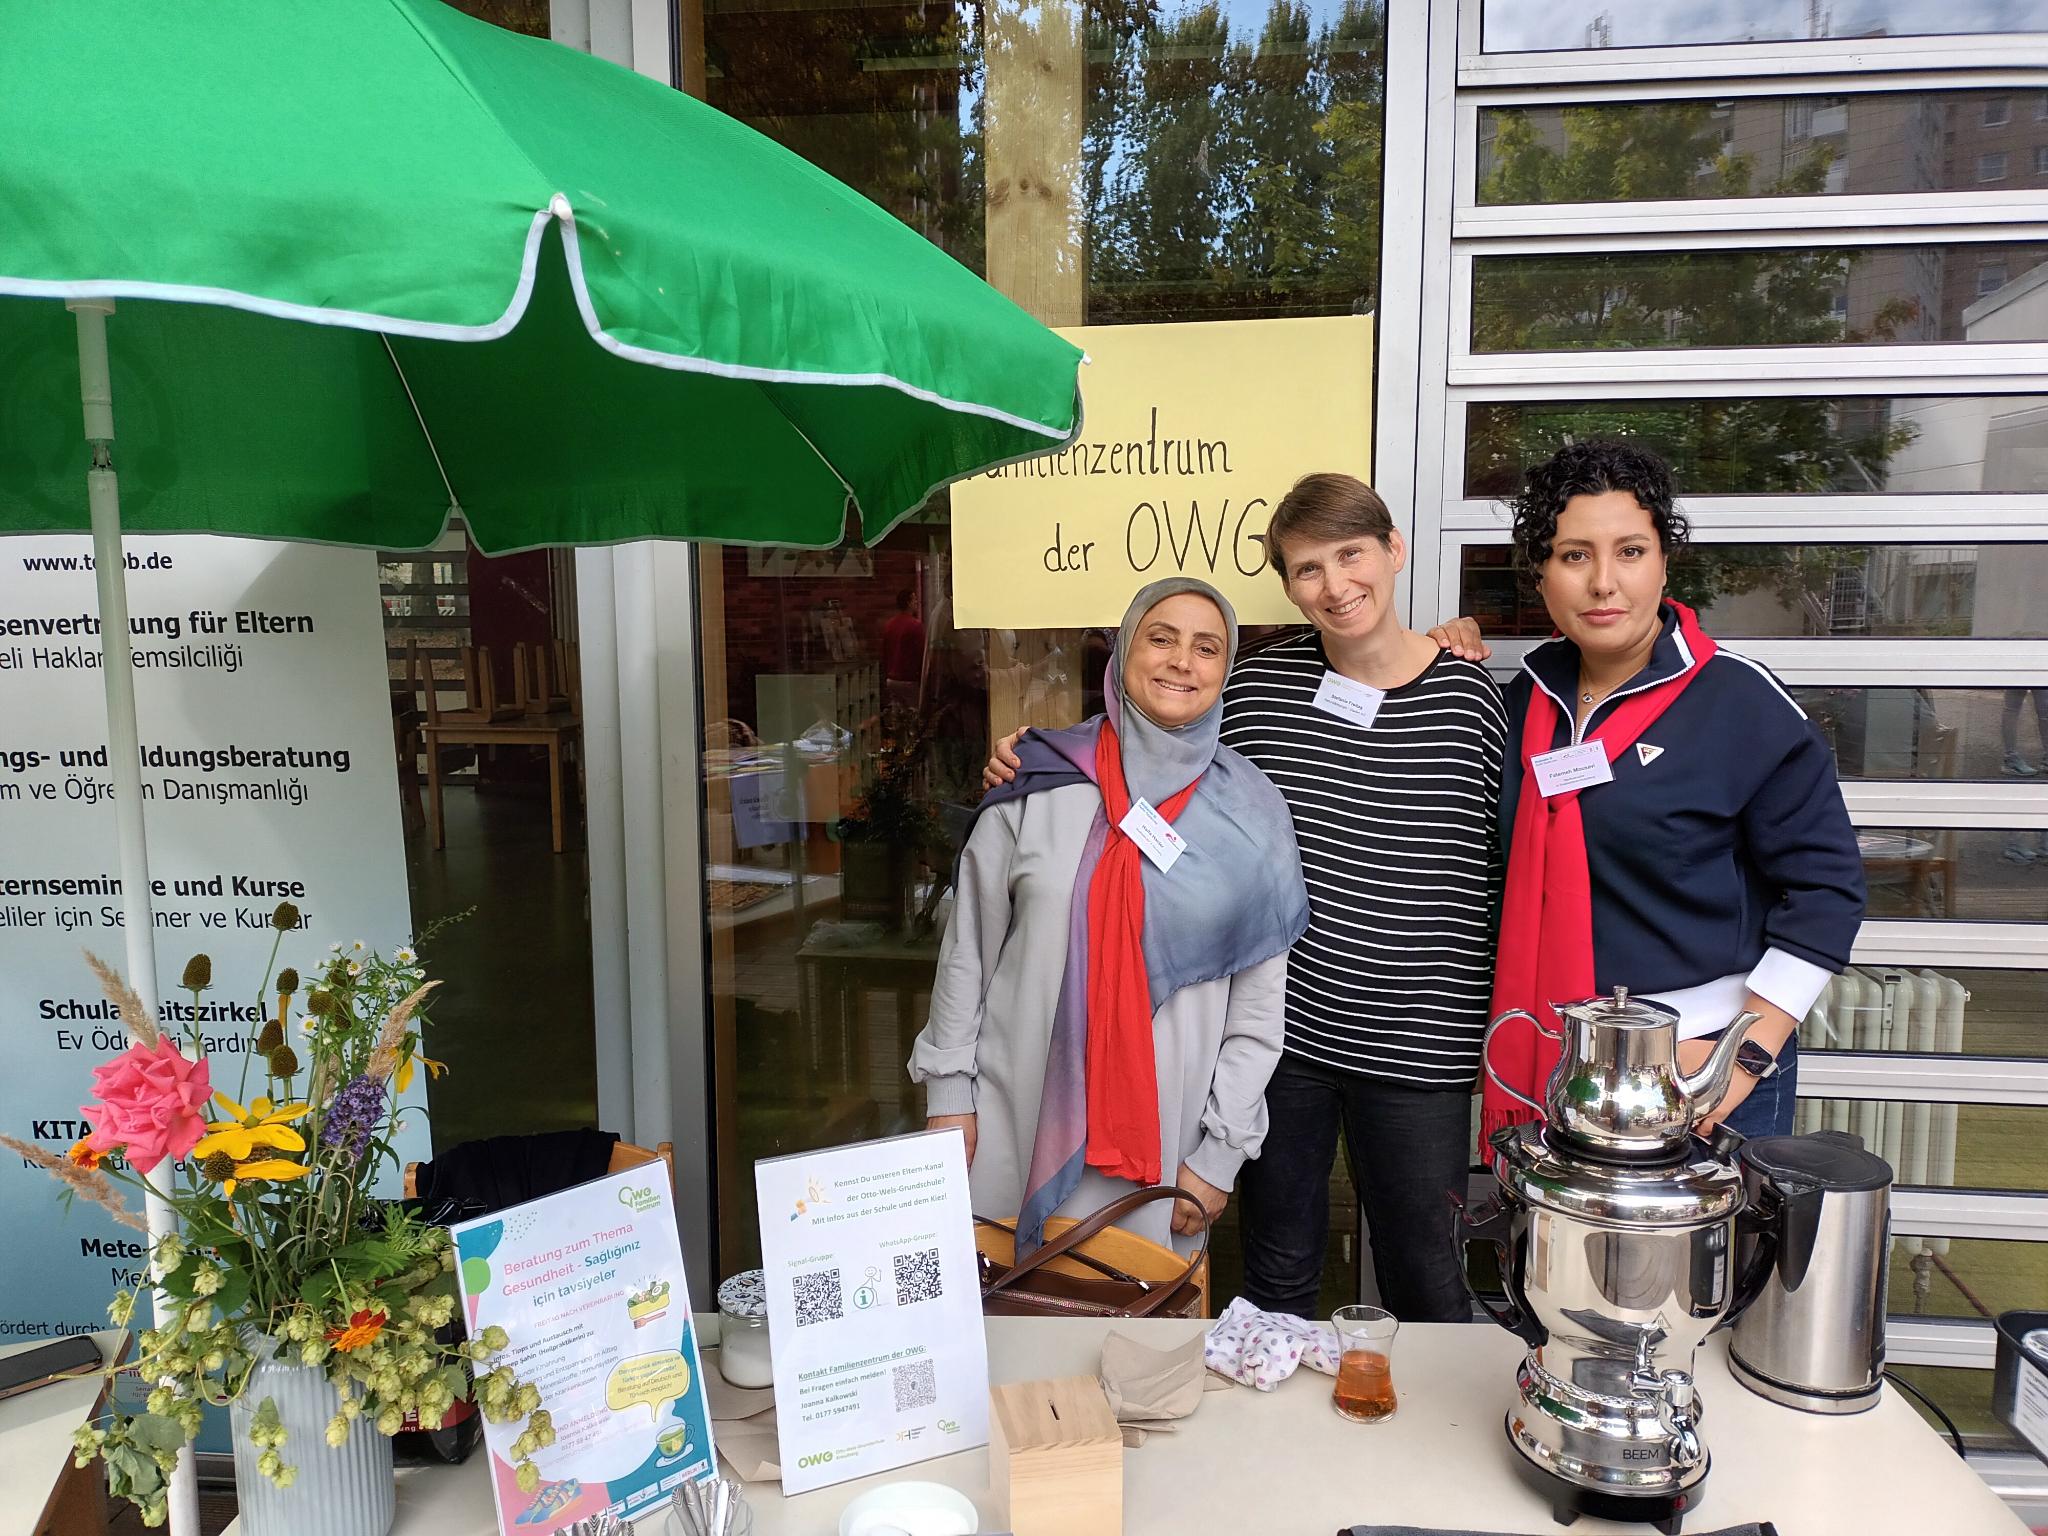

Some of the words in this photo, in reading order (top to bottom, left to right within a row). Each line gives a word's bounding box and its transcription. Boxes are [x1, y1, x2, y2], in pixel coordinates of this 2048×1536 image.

[1043, 522, 1095, 572] der
[1126, 498, 1268, 577] OWG
[0, 613, 181, 639] senvertrung
[188, 611, 228, 634] für
[235, 610, 314, 634] Eltern
[32, 645, 104, 669] Haklar
[130, 643, 243, 673] emsilciliği
[59, 745, 108, 767] und
[140, 745, 351, 772] ldungsberatung
[28, 783, 57, 800] ve
[163, 778, 309, 806] Danışmanlığı
[174, 875, 223, 896] und
[232, 876, 305, 898] Kurse
[54, 906, 93, 931] için
[100, 906, 191, 928] Seiner
[200, 911, 227, 928] ve
[235, 907, 312, 930] Kurar
[39, 999, 268, 1022] Schulaeitszirkel
[57, 1030, 83, 1050] Ev
[834, 1176, 860, 1188] Kennst
[861, 1174, 871, 1183] Du
[872, 1170, 901, 1181] unseren
[902, 1161, 944, 1176] Eltern-Kanal
[846, 1193, 859, 1202] der
[860, 1176, 946, 1201] Otto-Wels-Grundschule?
[812, 1216, 825, 1226] Mit
[826, 1211, 845, 1223] Infos
[846, 1210, 859, 1219] aus
[860, 1206, 872, 1216] der
[873, 1201, 897, 1214] Schule
[898, 1199, 913, 1209] und
[913, 1196, 929, 1206] dem
[930, 1191, 947, 1204] Kiez!
[503, 1247, 562, 1276] Beratung
[565, 1238, 591, 1255] zum
[592, 1222, 634, 1244] Thema
[502, 1264, 575, 1296] Gesundheit
[584, 1240, 641, 1268] Sağlığınız
[533, 1290, 556, 1308] için
[558, 1268, 617, 1298] tavsiyeler
[529, 1338, 542, 1349] und
[573, 1323, 584, 1331] mit
[798, 1366, 828, 1382] Kontakt
[829, 1353, 890, 1375] Familienzentrum
[891, 1349, 904, 1359] der
[905, 1344, 927, 1357] OWG:
[799, 1387, 810, 1396] Bei
[811, 1381, 834, 1394] Fragen
[834, 1376, 859, 1388] einfach
[860, 1369, 887, 1382] melden!
[800, 1398, 824, 1410] Joanna
[802, 1414, 814, 1423] Tel.
[815, 1410, 832, 1420] 0177
[797, 1450, 833, 1469] OWG
[1623, 1448, 1659, 1460] BEEM
